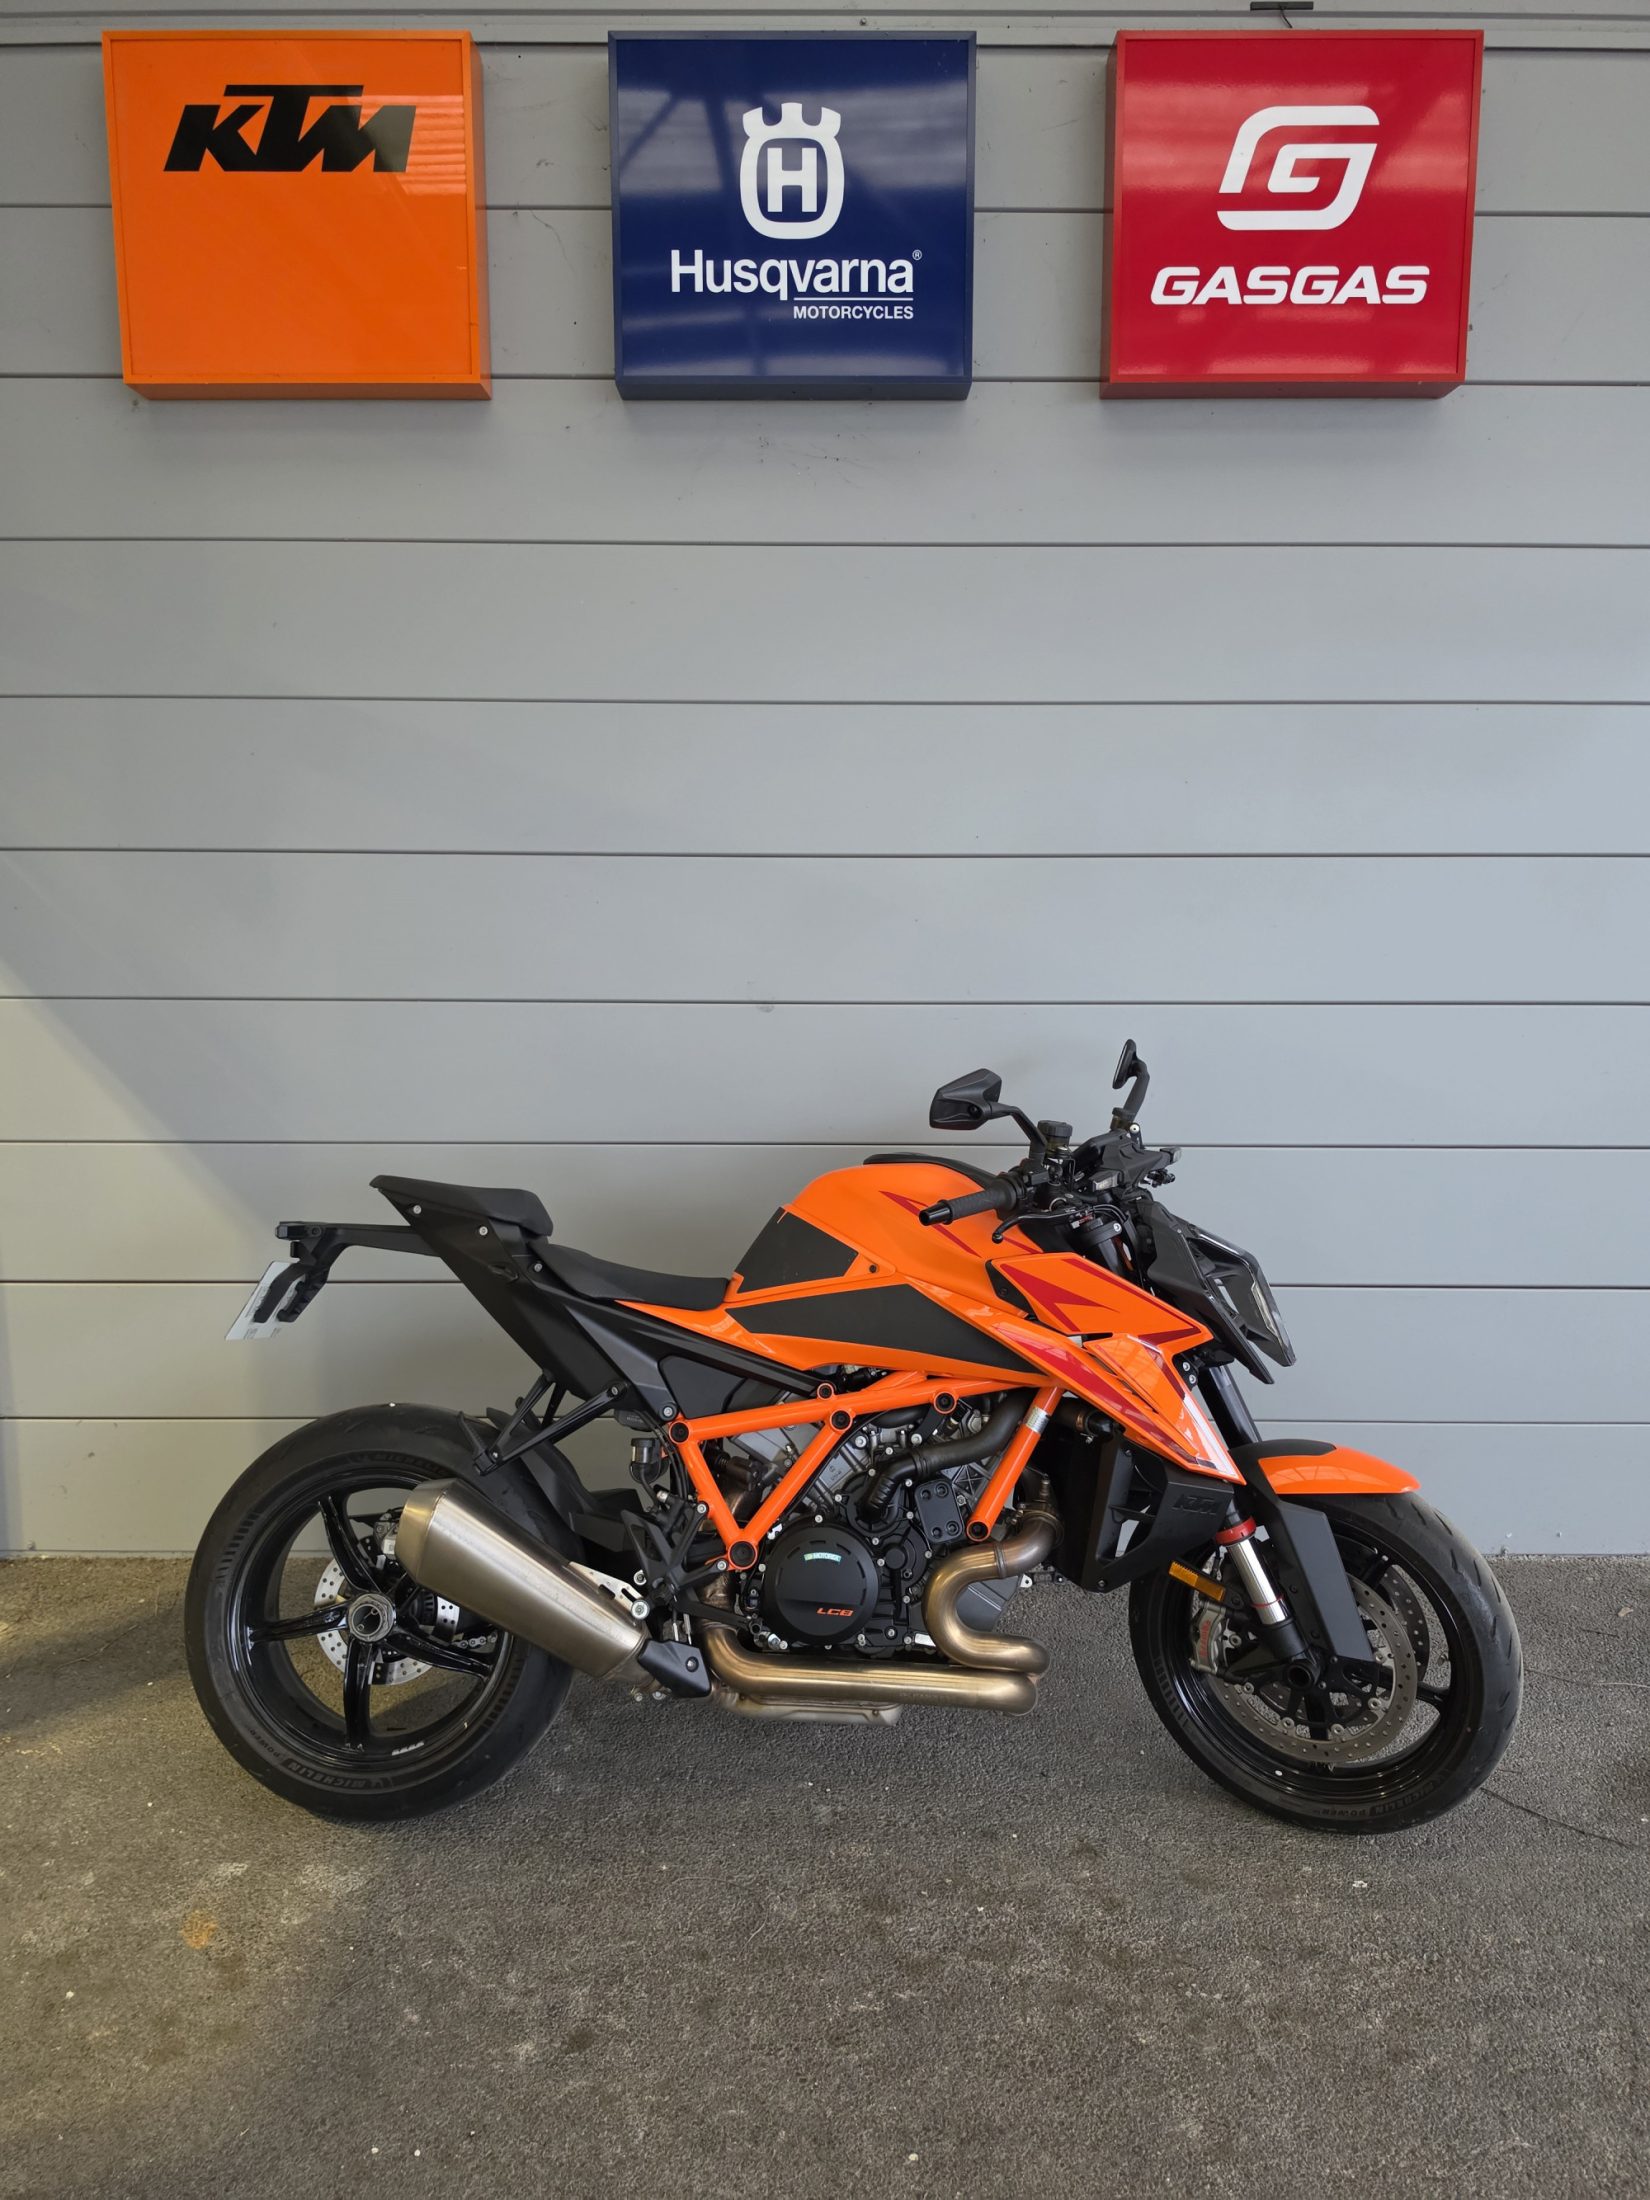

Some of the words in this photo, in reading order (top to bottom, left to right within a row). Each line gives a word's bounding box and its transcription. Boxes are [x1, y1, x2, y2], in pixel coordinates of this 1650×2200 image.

[163, 84, 416, 172] KTM
[767, 147, 818, 213] H
[1150, 265, 1430, 305] GASGAS
[793, 305, 914, 320] MOTORCYCLES
[816, 1607, 854, 1617] LC8
[287, 1761, 367, 1789] MICHELIN
